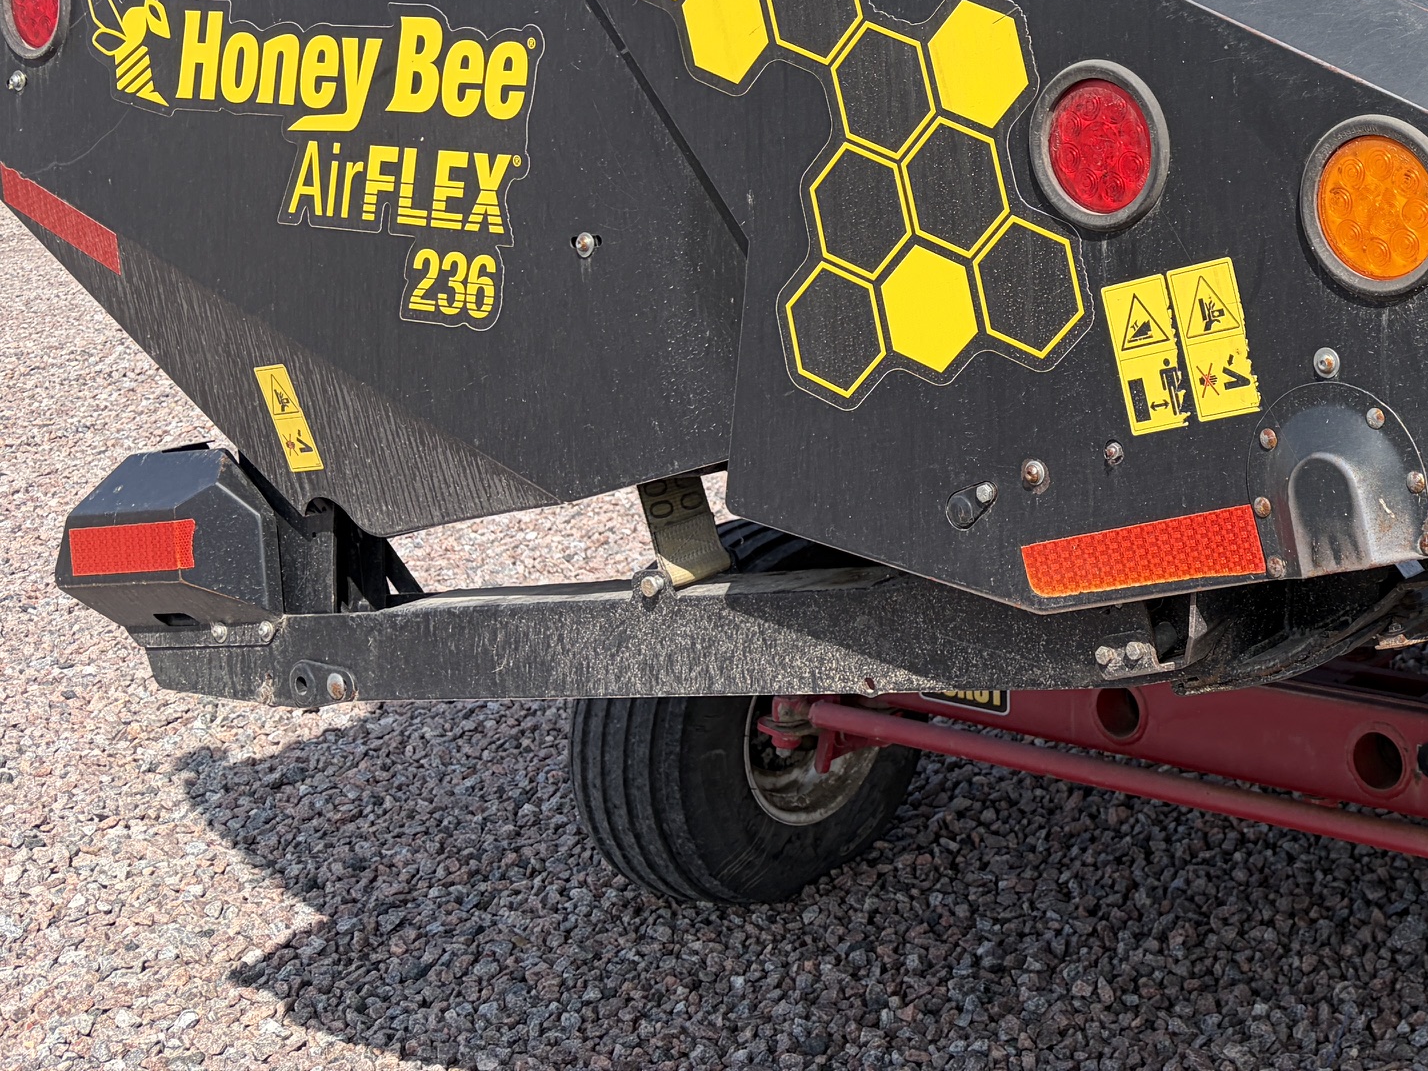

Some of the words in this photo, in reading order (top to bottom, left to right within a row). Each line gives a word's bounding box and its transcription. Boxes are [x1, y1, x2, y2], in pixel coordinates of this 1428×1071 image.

[175, 10, 383, 132] Honey
[385, 16, 528, 120] Bee
[408, 248, 496, 319] 236
